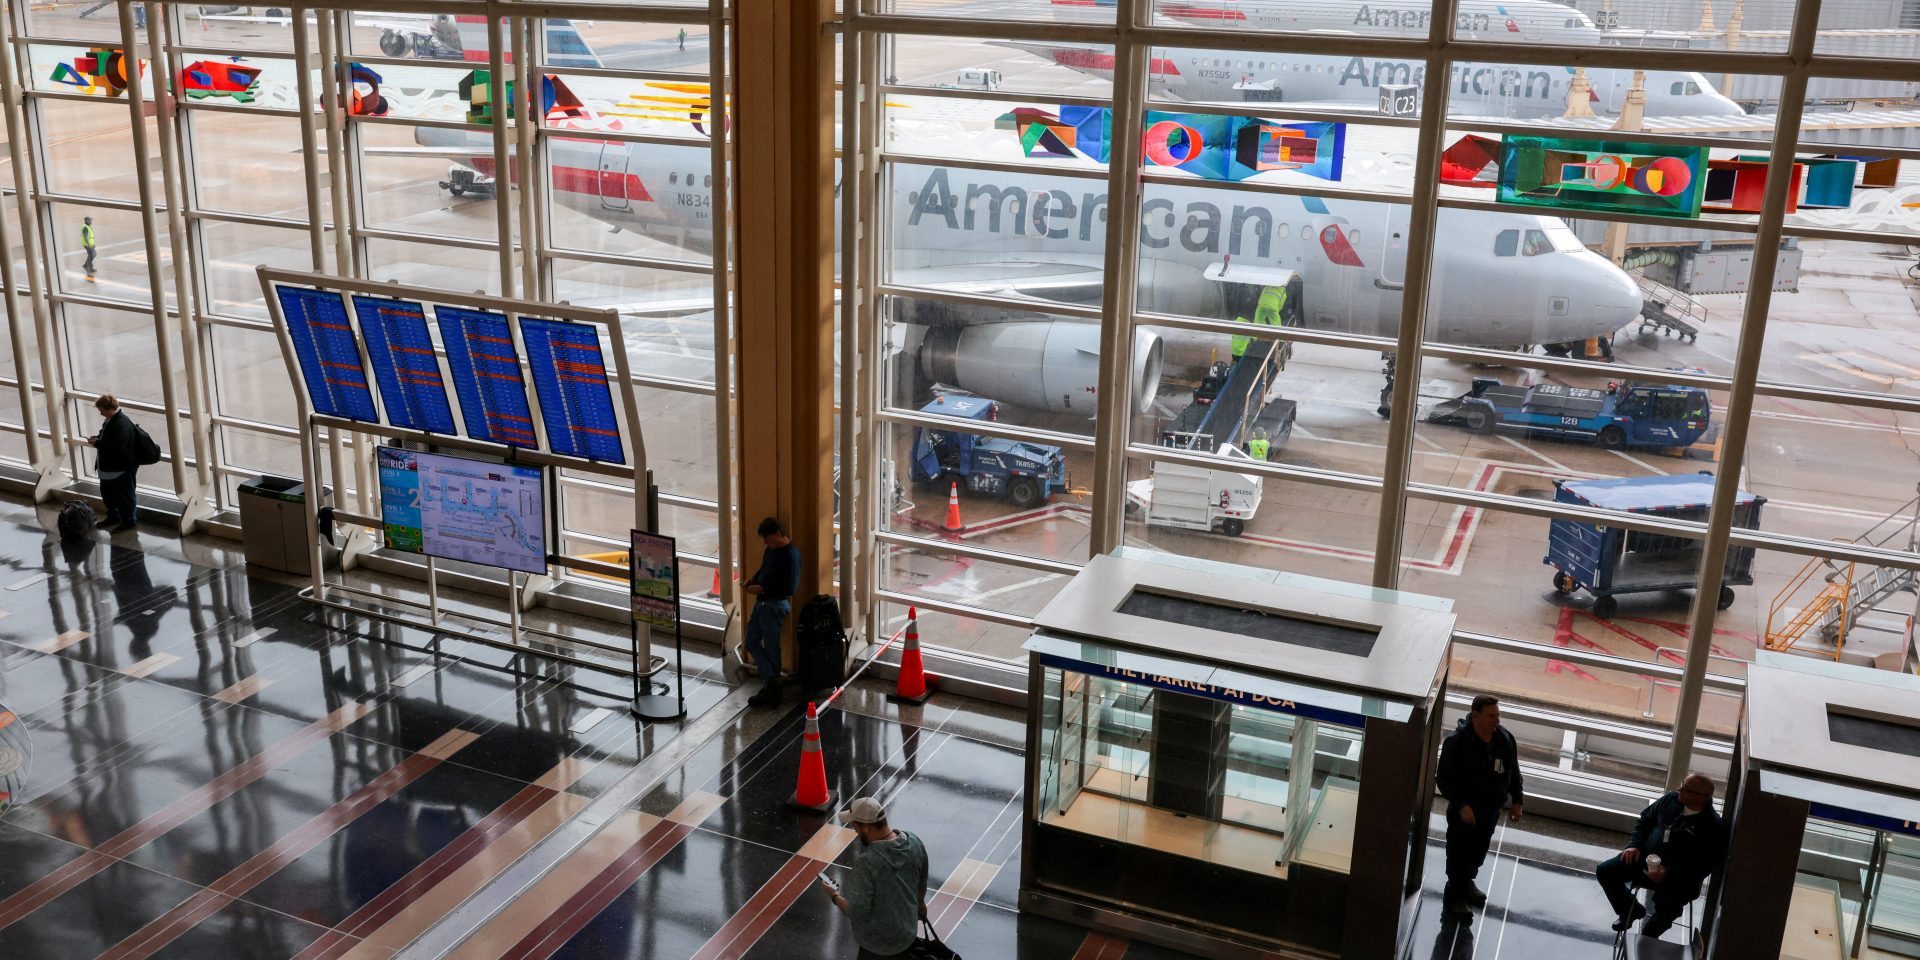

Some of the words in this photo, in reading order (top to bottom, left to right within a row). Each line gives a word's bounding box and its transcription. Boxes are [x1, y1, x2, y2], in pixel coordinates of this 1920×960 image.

[1352, 4, 1490, 31] Ameran
[1198, 69, 1231, 80] N755US
[1338, 57, 1551, 99] Amican
[1380, 95, 1390, 115] C23
[1394, 95, 1415, 115] C23
[695, 211, 708, 219] 834
[907, 167, 1275, 259] Amercan
[1561, 416, 1579, 426] 128
[391, 459, 410, 471] RIDE
[978, 455, 997, 463] American
[1015, 460, 1035, 469] TK055
[383, 485, 397, 493] LEVEL
[408, 487, 421, 509] 2
[634, 536, 647, 544] DCA
[648, 538, 673, 548] DISCOVER
